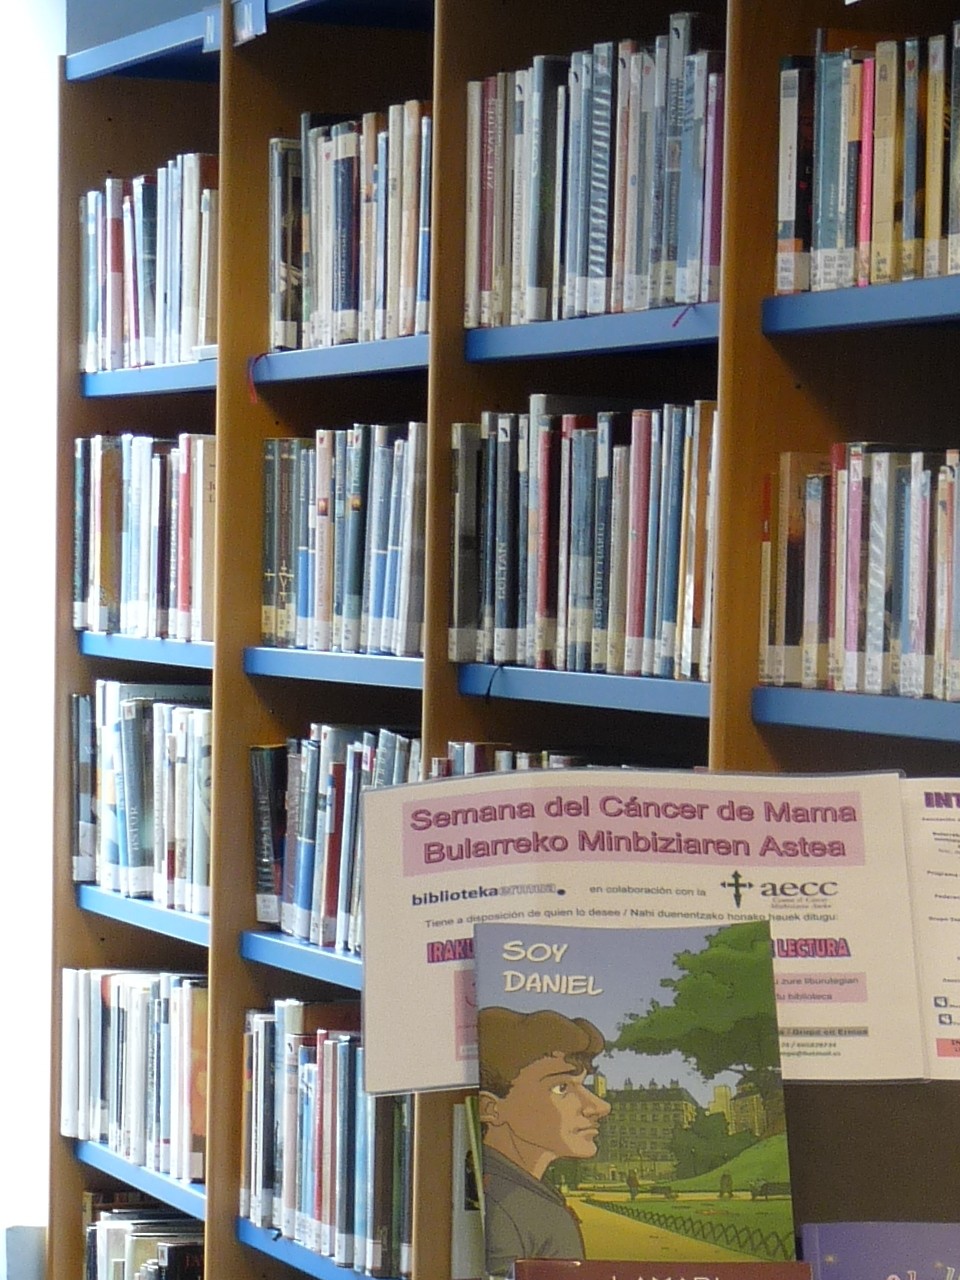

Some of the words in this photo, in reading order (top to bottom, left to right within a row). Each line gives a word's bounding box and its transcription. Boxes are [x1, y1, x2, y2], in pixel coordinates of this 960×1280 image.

[410, 800, 536, 831] Semana
[543, 796, 589, 819] del
[599, 794, 710, 821] Cáncer
[717, 799, 756, 823] de
[764, 801, 858, 824] Mama
[424, 833, 569, 864] Bularreko
[578, 829, 752, 858] Minbiziaren
[758, 835, 846, 859] Astea
[589, 886, 603, 894] en
[606, 884, 672, 897] colaboración
[675, 888, 694, 897] con
[697, 887, 707, 897] la
[760, 880, 839, 898] aecc
[425, 918, 455, 929] Tiene
[466, 911, 525, 925] disposición
[528, 908, 541, 919] de
[544, 907, 573, 919] quien
[588, 907, 621, 918] desee
[630, 908, 655, 918] Nahi
[658, 910, 724, 921] duenentzako
[727, 912, 765, 922] honako
[768, 913, 801, 923] hauek
[502, 940, 568, 964] SOY
[776, 938, 852, 958] LECTURA
[503, 970, 604, 996] DANIEL
